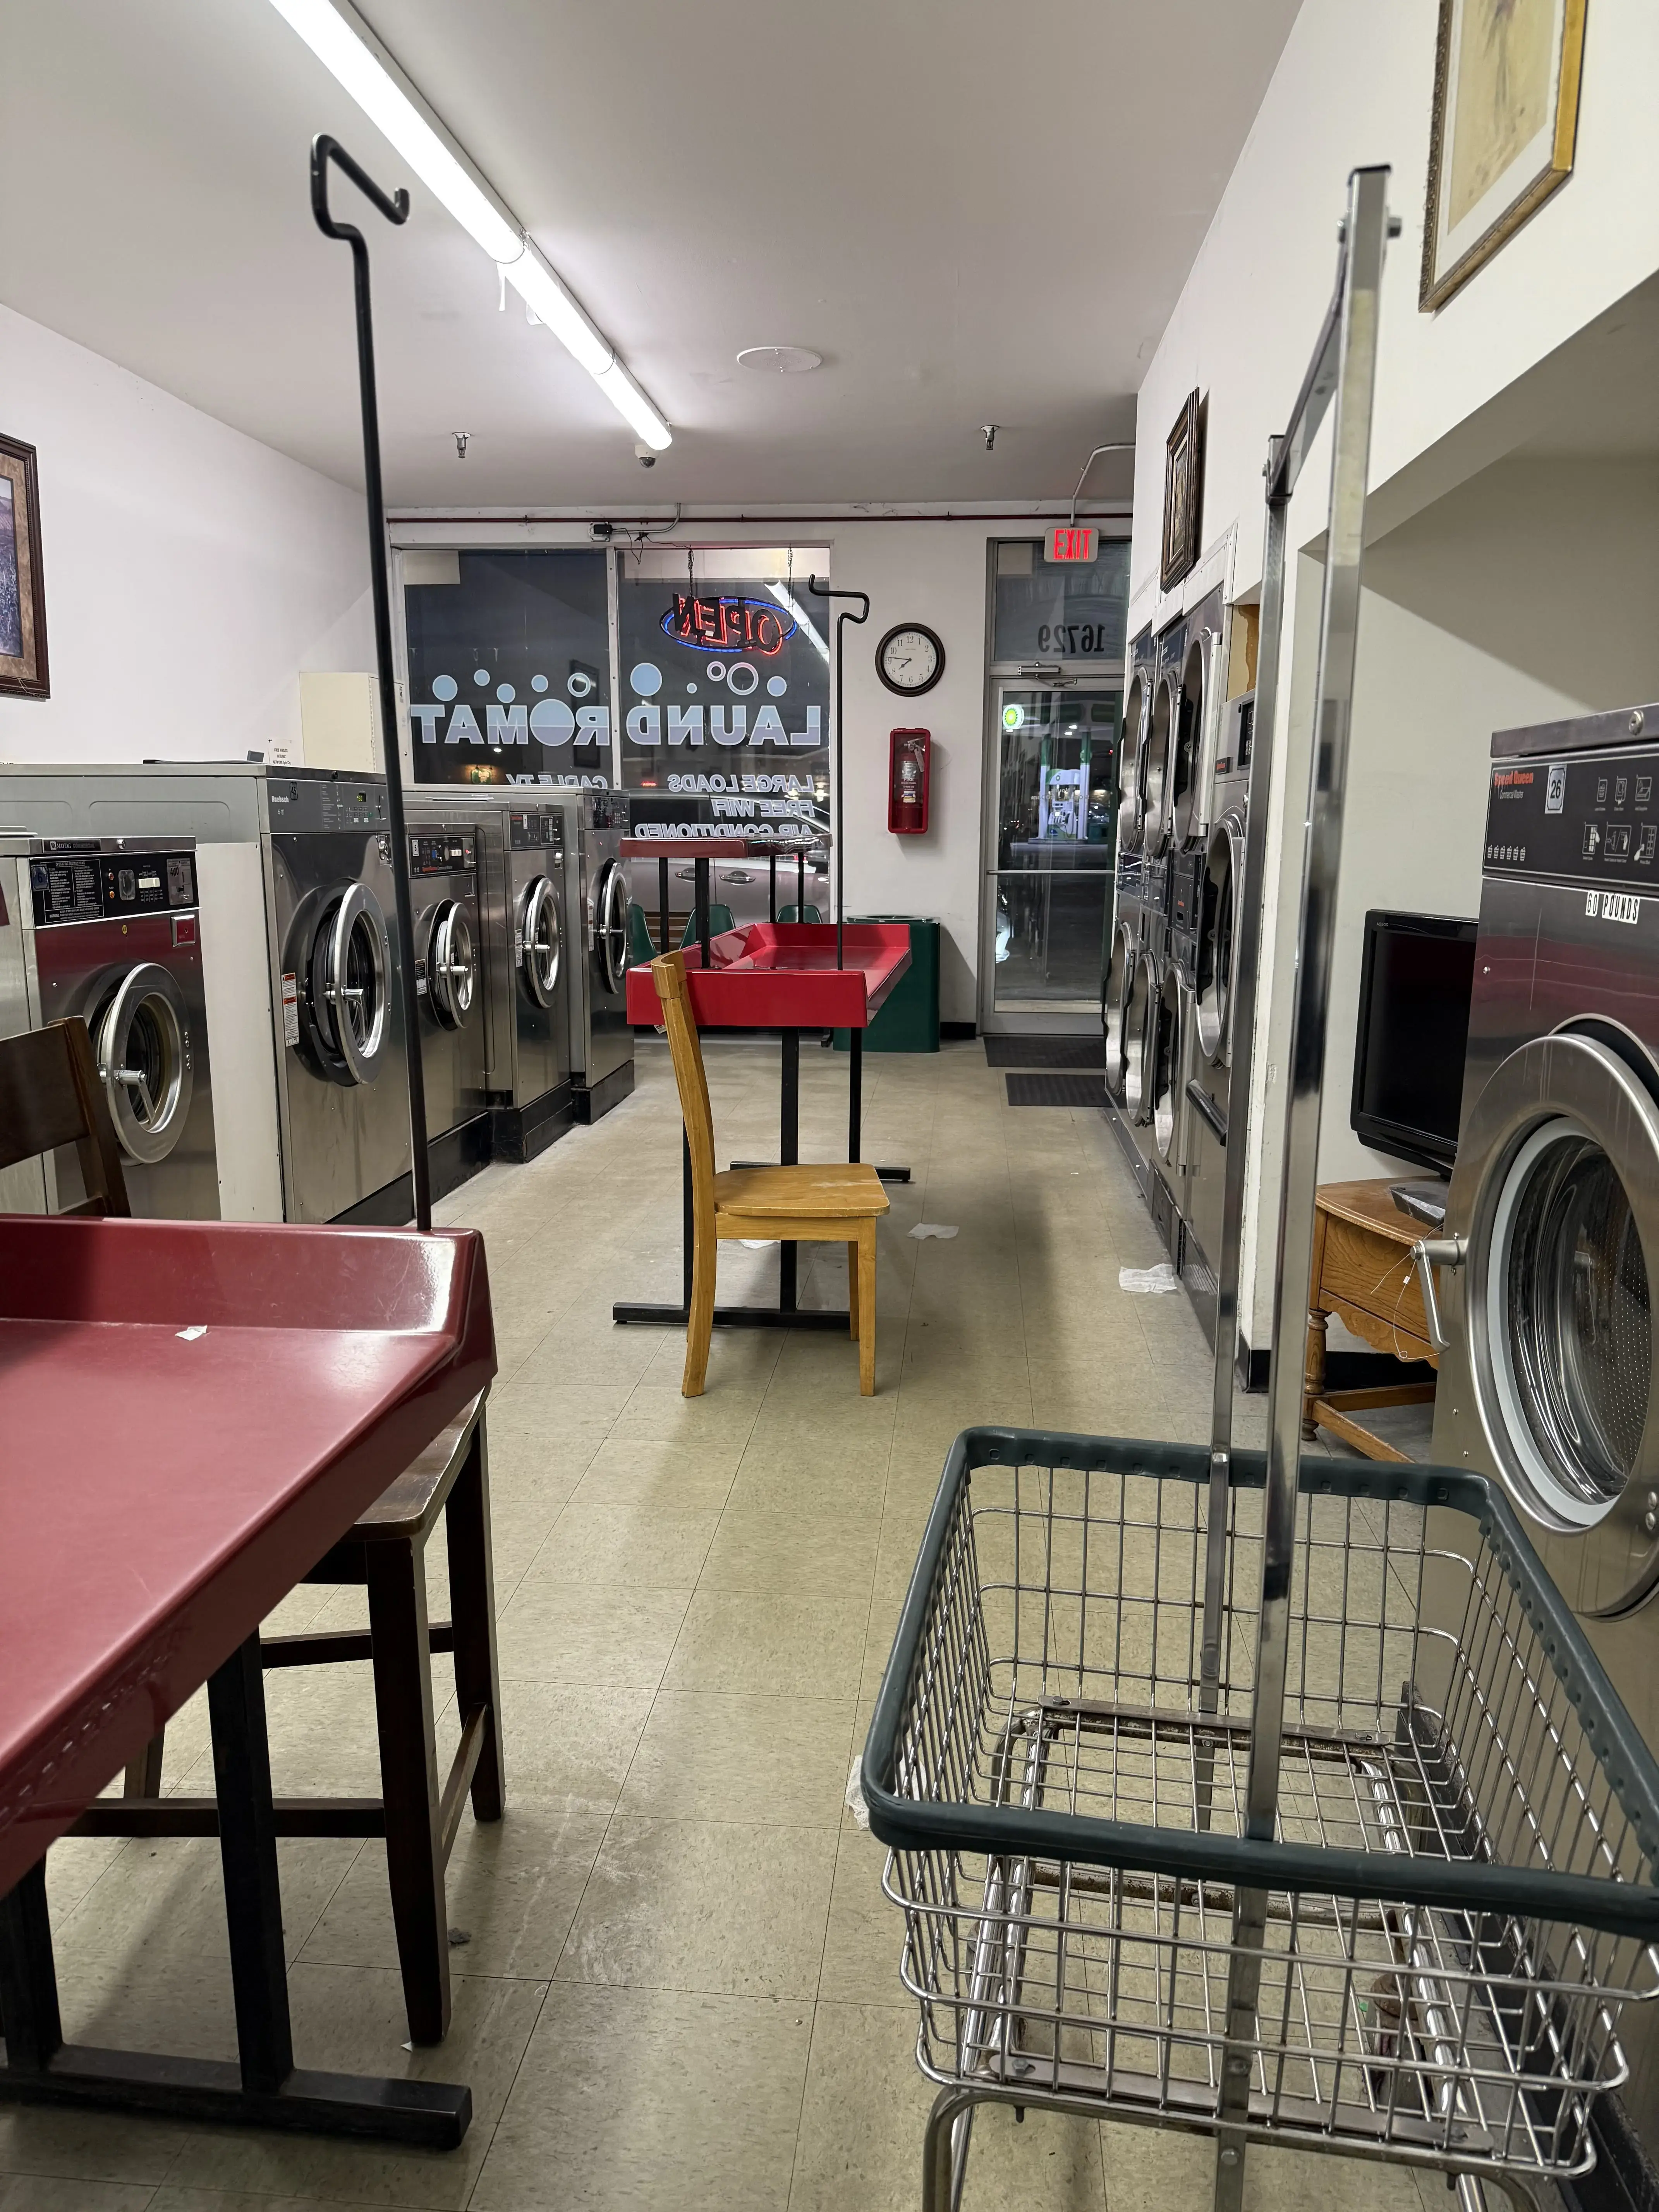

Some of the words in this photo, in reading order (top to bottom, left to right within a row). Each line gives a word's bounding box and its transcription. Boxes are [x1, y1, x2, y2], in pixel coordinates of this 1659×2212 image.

[1053, 529, 1092, 560] EXIT
[919, 674, 923, 682] 5
[1513, 771, 1534, 784] Queen
[291, 787, 297, 796] 45
[1550, 780, 1561, 799] 26
[38, 872, 43, 883] 6
[170, 867, 179, 876] 400
[1587, 893, 1597, 914] 60
[1603, 895, 1638, 921] POUNDS
